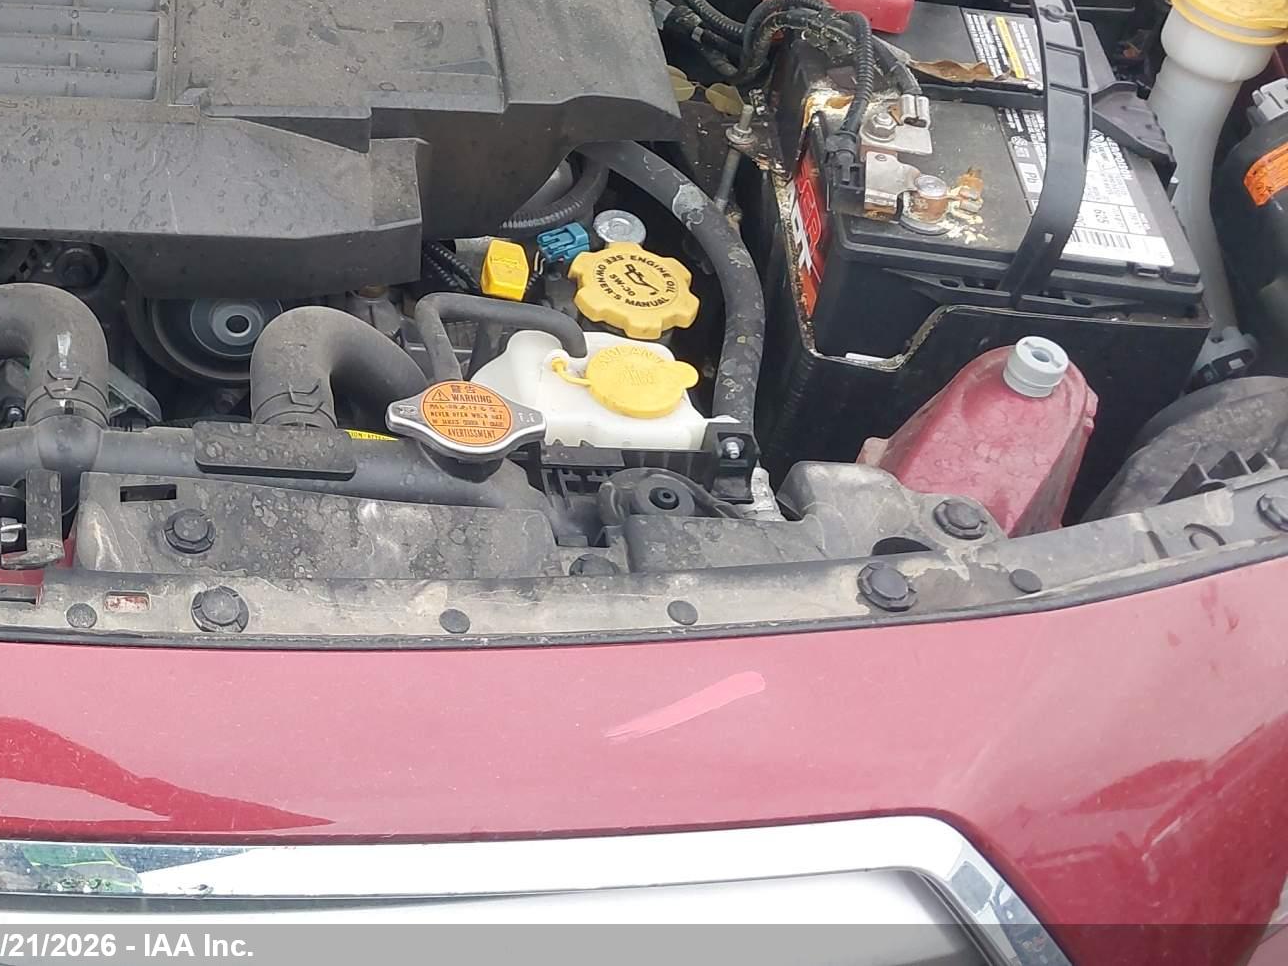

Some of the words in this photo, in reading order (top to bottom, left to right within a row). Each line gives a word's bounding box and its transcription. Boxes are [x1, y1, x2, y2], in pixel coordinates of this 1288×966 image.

[606, 254, 625, 265] SEE
[624, 296, 671, 308] MANUAL
[608, 273, 637, 297] 5W-30
[629, 255, 672, 278] ENGINE
[665, 280, 677, 294] OIL
[451, 393, 493, 404] WARNING
